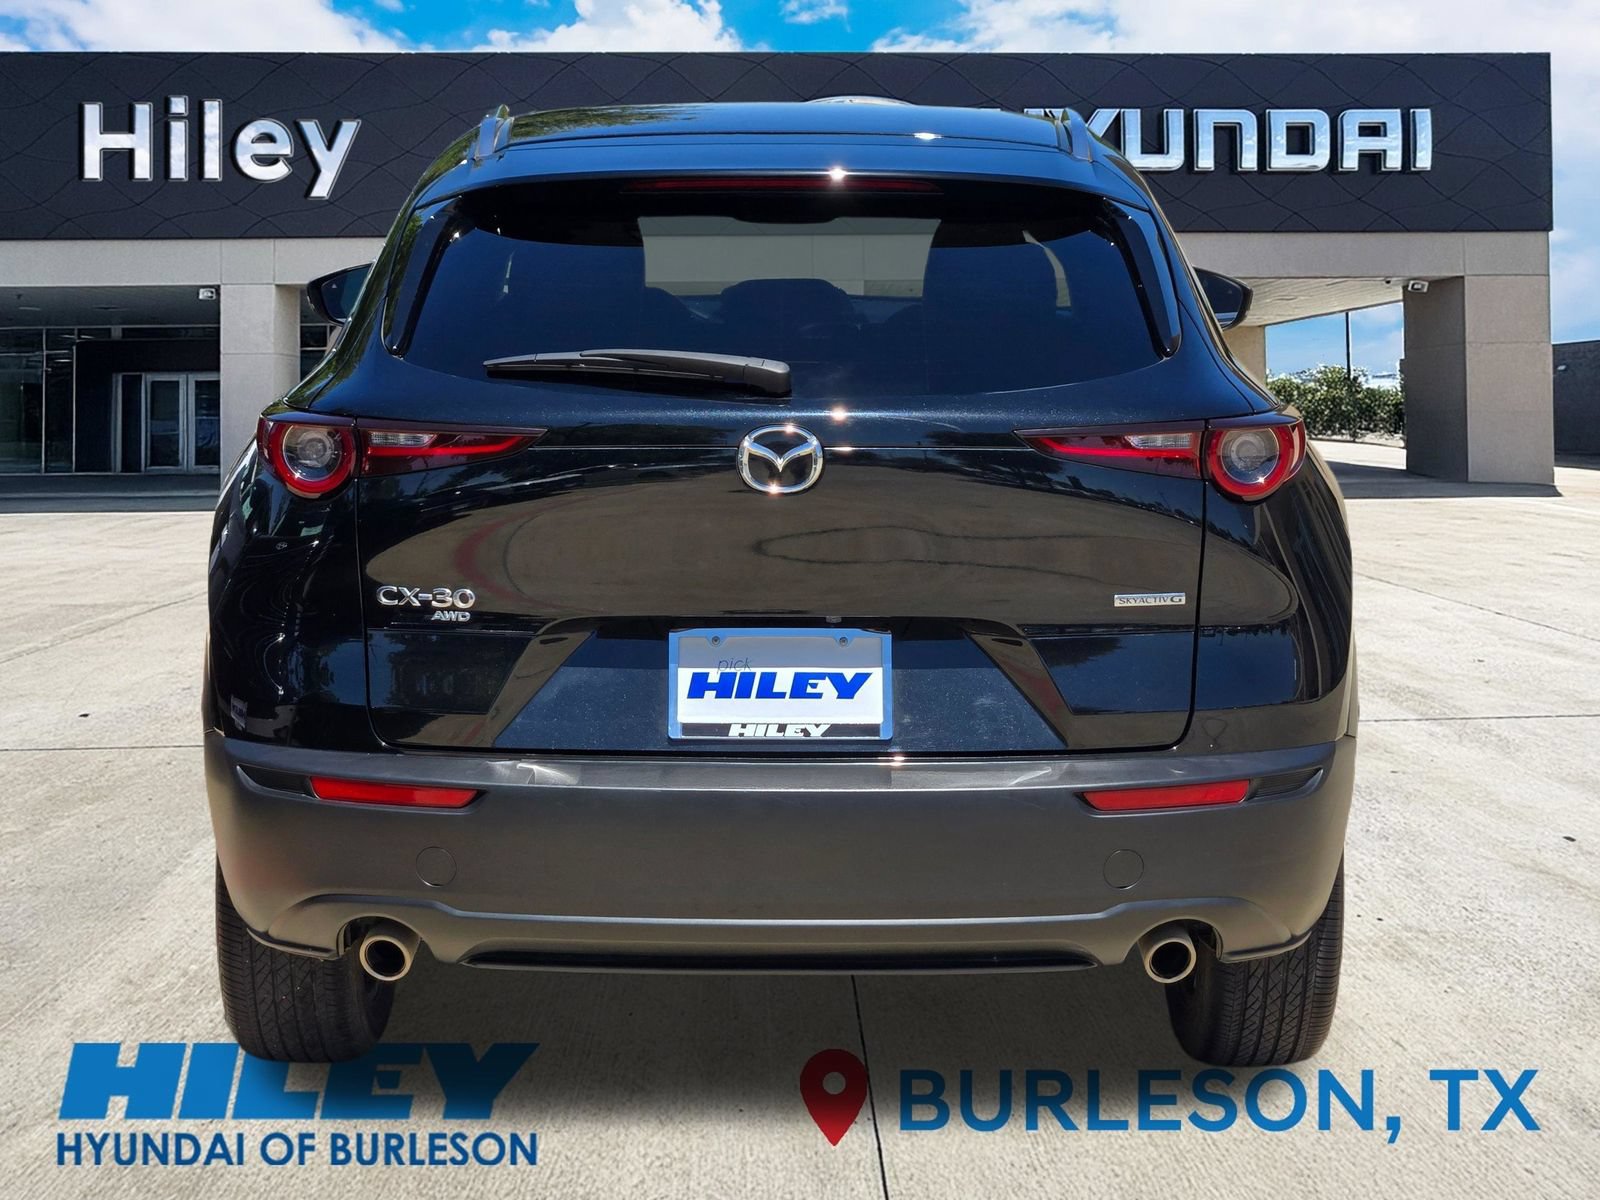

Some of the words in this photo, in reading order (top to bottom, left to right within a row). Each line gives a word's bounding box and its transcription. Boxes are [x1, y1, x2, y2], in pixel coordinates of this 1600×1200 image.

[82, 95, 362, 200] Hiley
[376, 585, 476, 609] CX-30
[430, 610, 471, 622] AWD
[716, 656, 752, 675] pick
[686, 671, 874, 700] HILEY
[727, 723, 833, 738] HILEY
